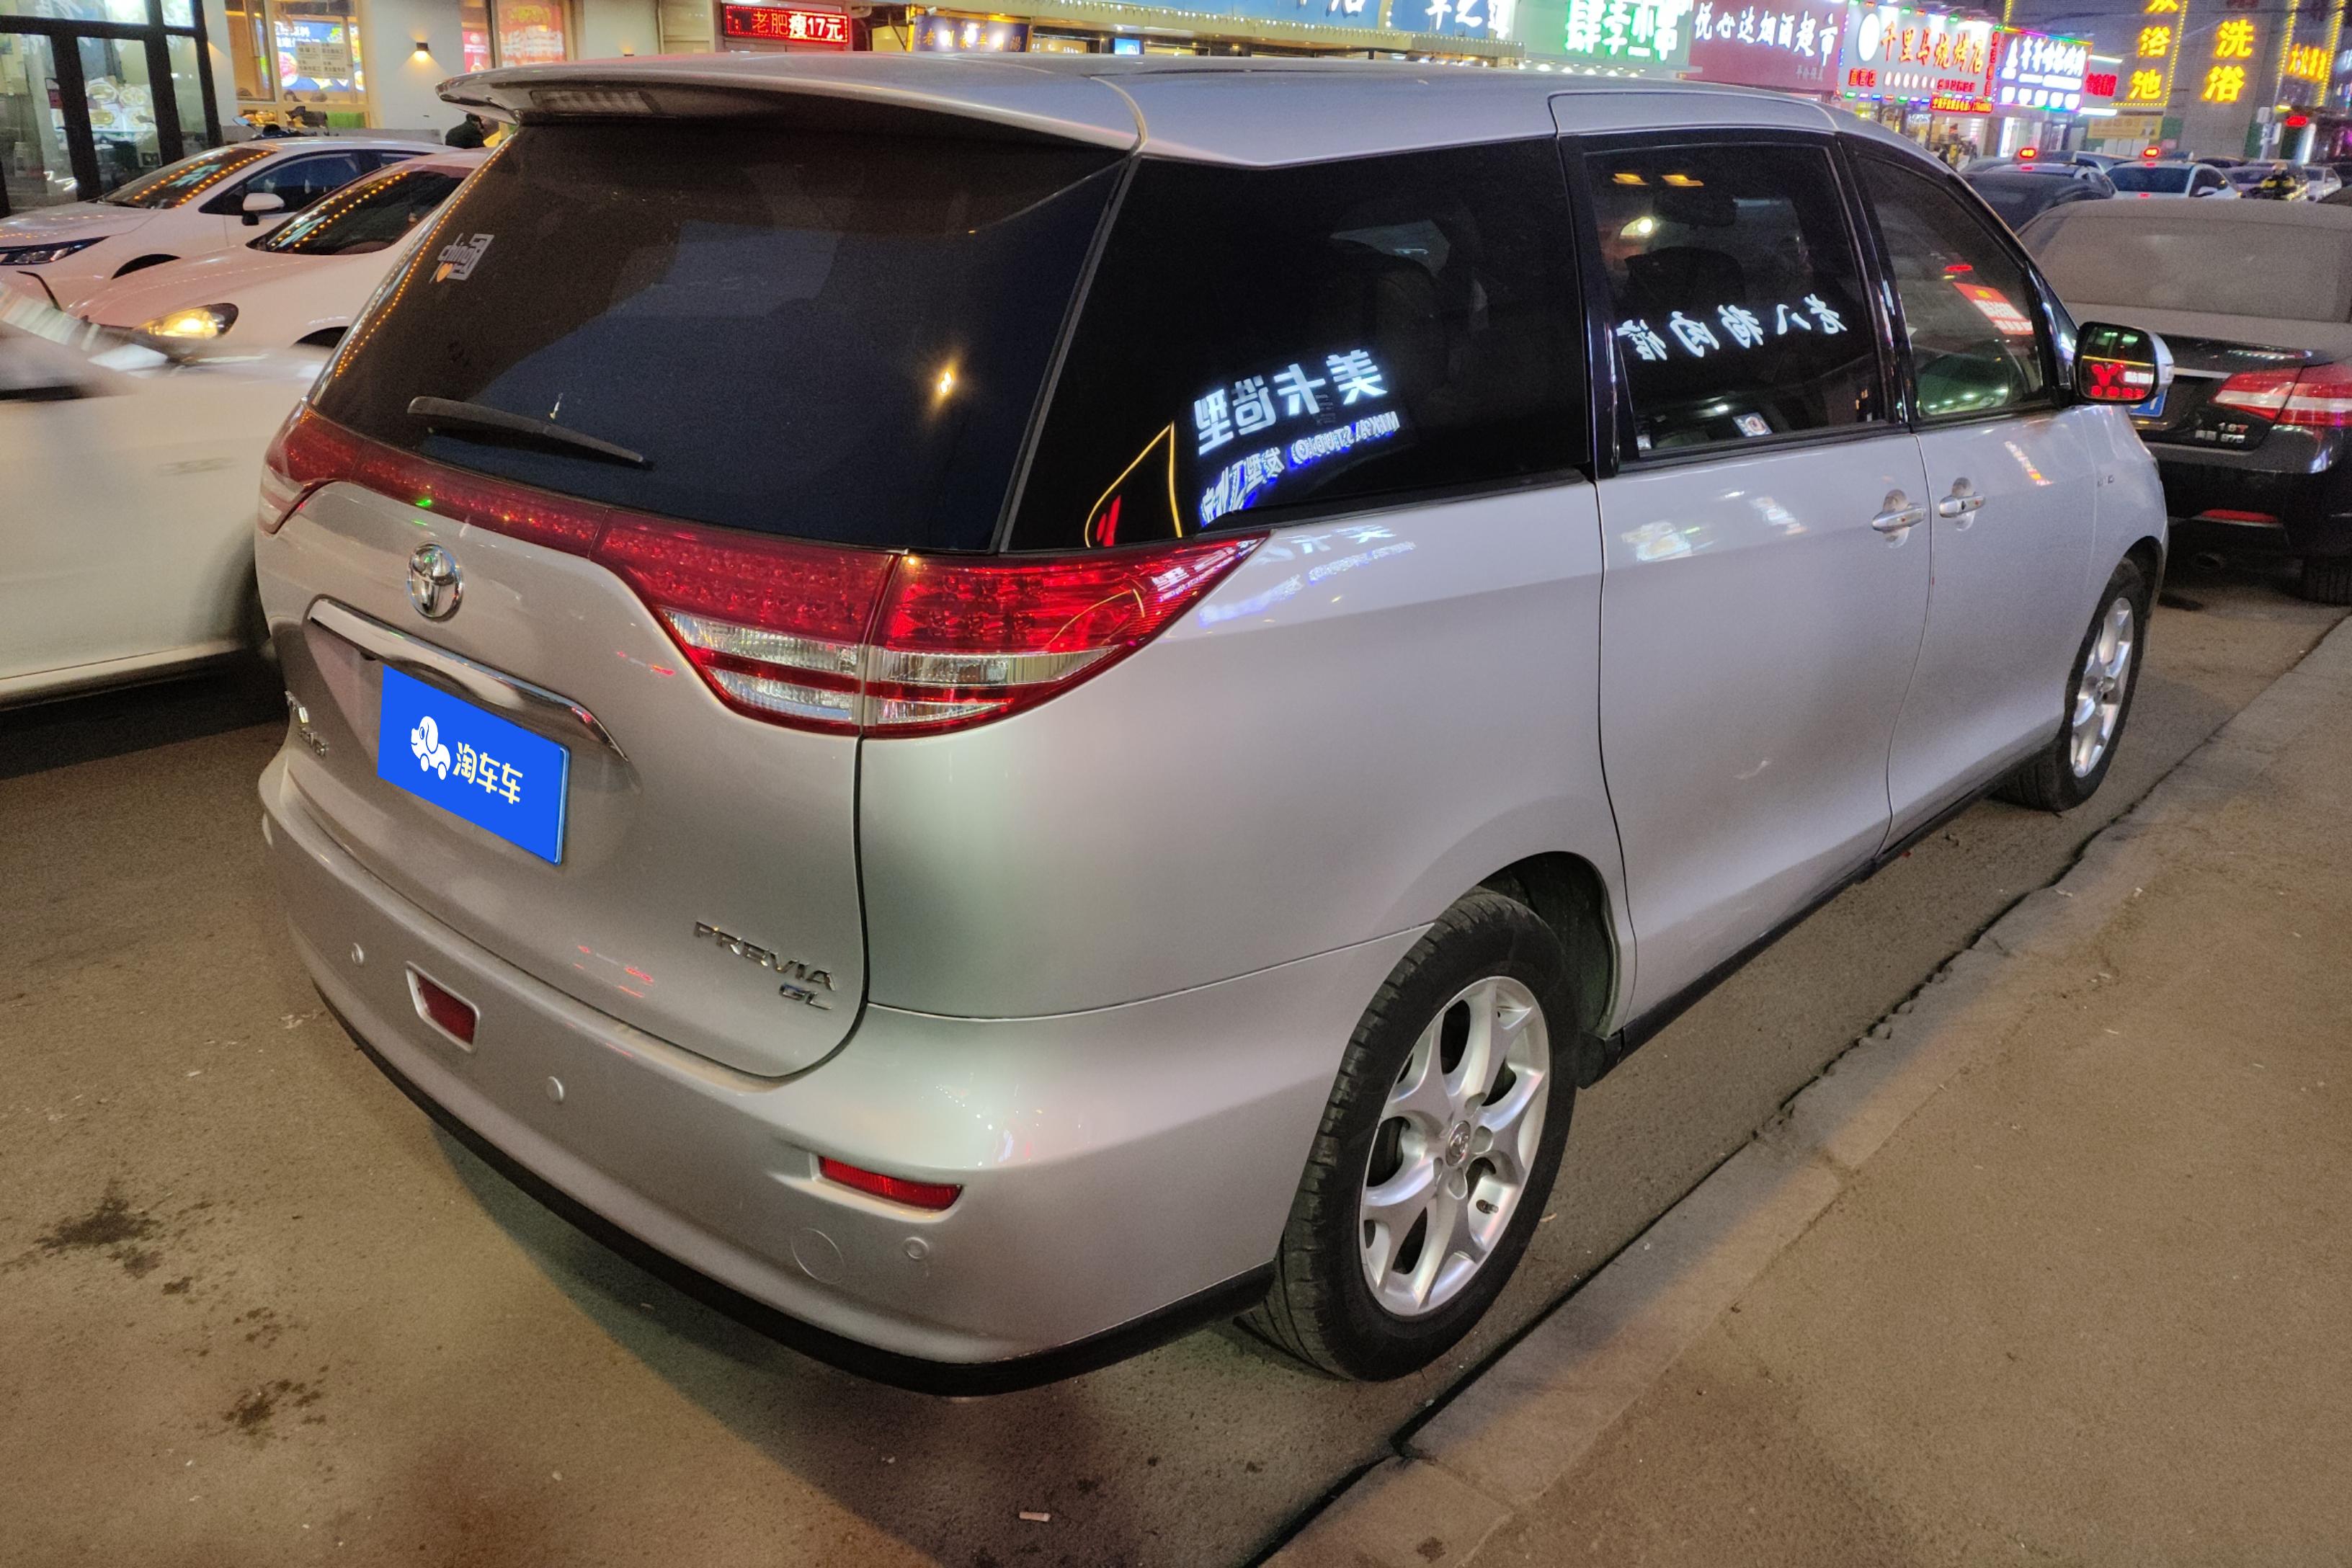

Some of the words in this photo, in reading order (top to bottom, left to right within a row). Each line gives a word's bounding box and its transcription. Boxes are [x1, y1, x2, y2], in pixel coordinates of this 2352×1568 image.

[1880, 21, 1984, 74] 千里马烧烤店
[2202, 19, 2254, 102] 洗浴
[693, 921, 836, 992] PREVIA
